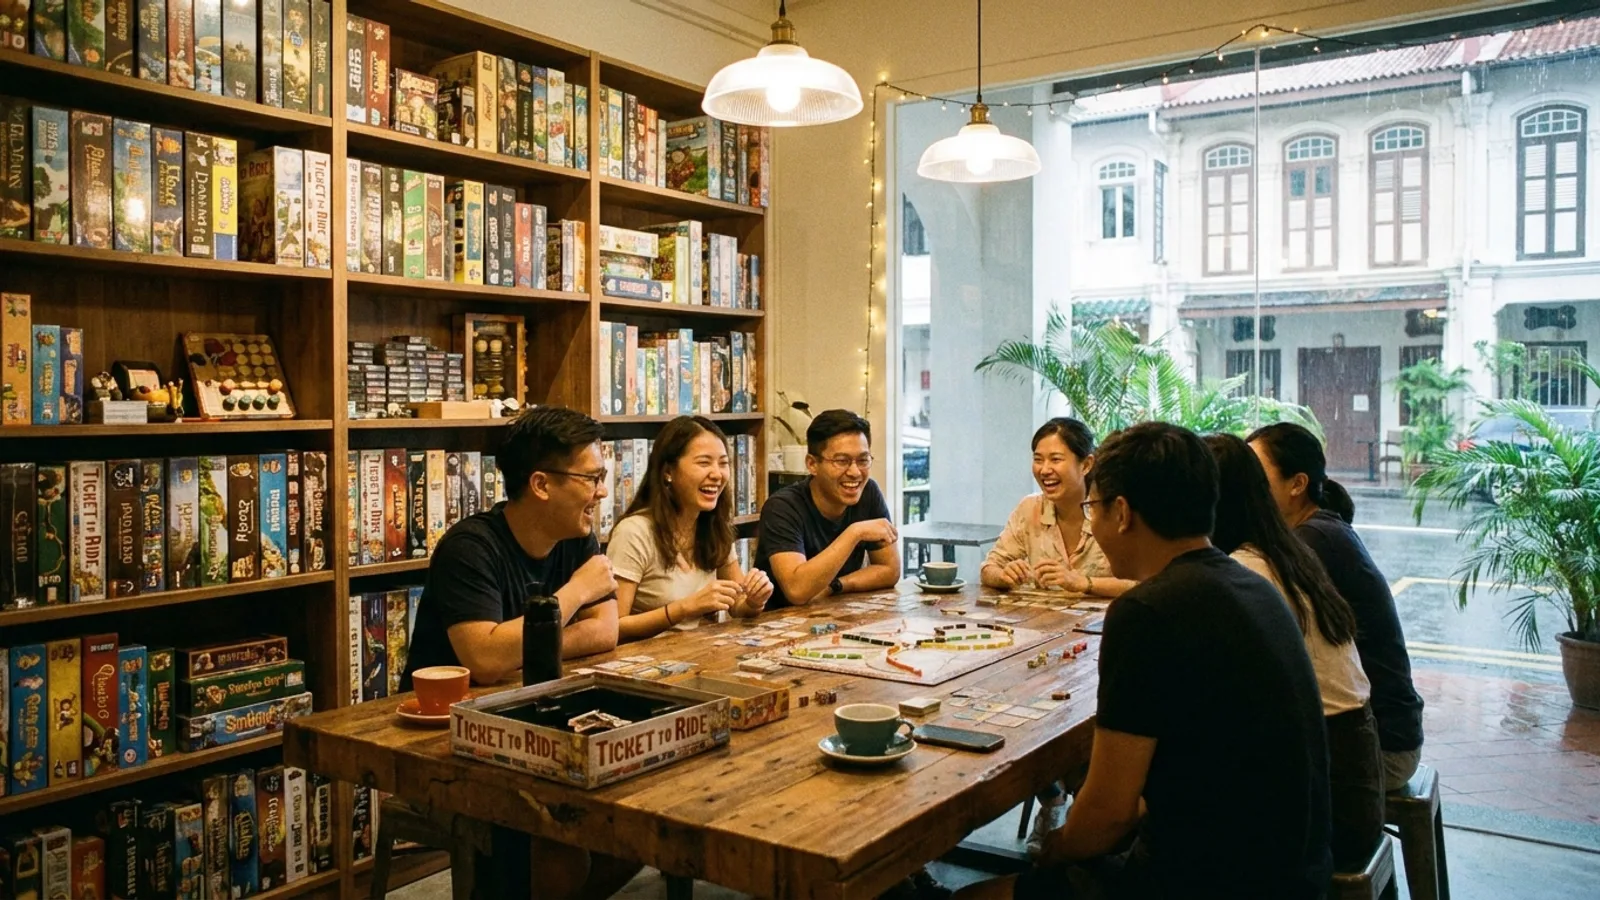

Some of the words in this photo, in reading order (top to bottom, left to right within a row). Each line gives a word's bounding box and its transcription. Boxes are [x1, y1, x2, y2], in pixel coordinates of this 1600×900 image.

[453, 713, 506, 749] TICKET
[508, 734, 522, 750] TO
[525, 729, 563, 764] RIDE
[595, 729, 655, 767] TICKET
[659, 727, 672, 746] TO
[675, 714, 708, 742] RIDE
